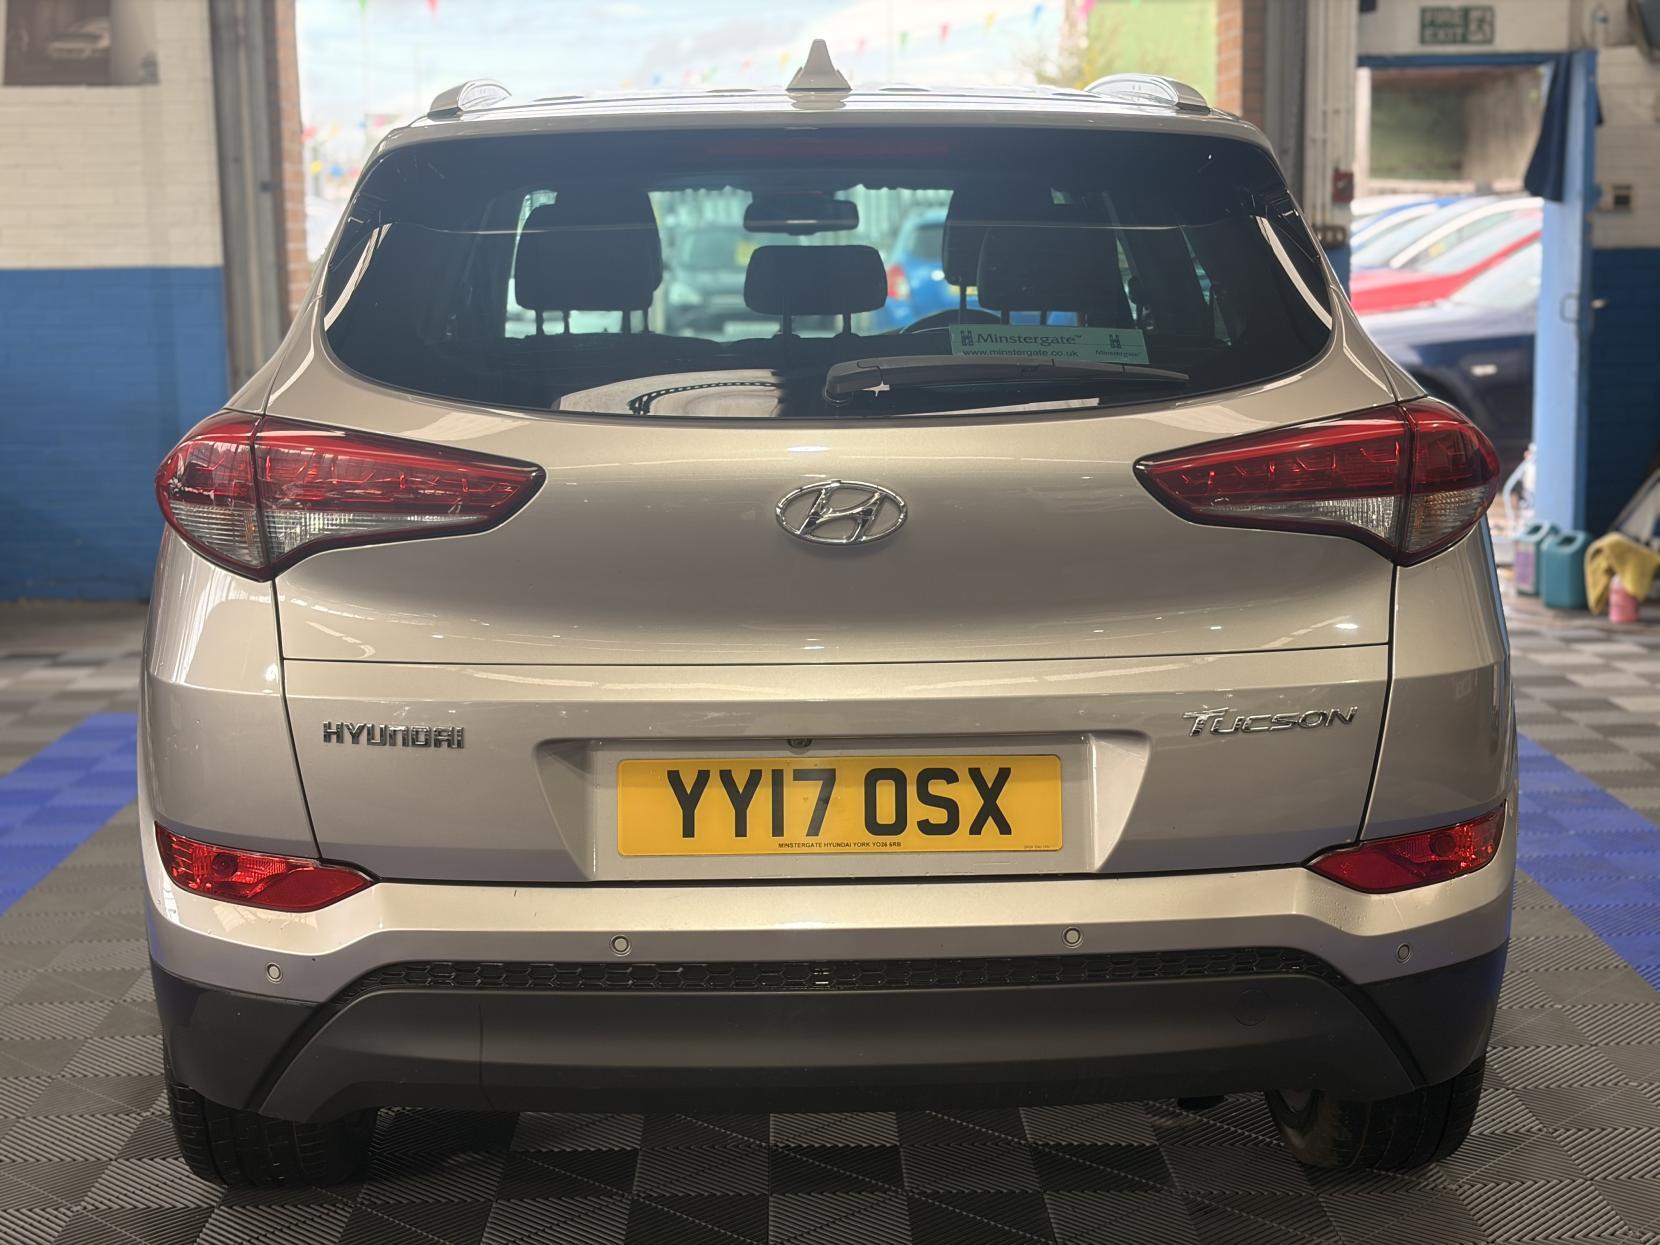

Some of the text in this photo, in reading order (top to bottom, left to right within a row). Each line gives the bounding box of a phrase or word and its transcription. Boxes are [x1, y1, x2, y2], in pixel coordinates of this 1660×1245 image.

[1424, 10, 1464, 24] FIRE
[1424, 27, 1464, 41] EXIT
[963, 349, 1079, 357] www.minstergate.co.uk
[1183, 706, 1358, 736] TUCSON
[323, 721, 464, 749] HYUNDAI
[667, 767, 1012, 838] YY17 OSX
